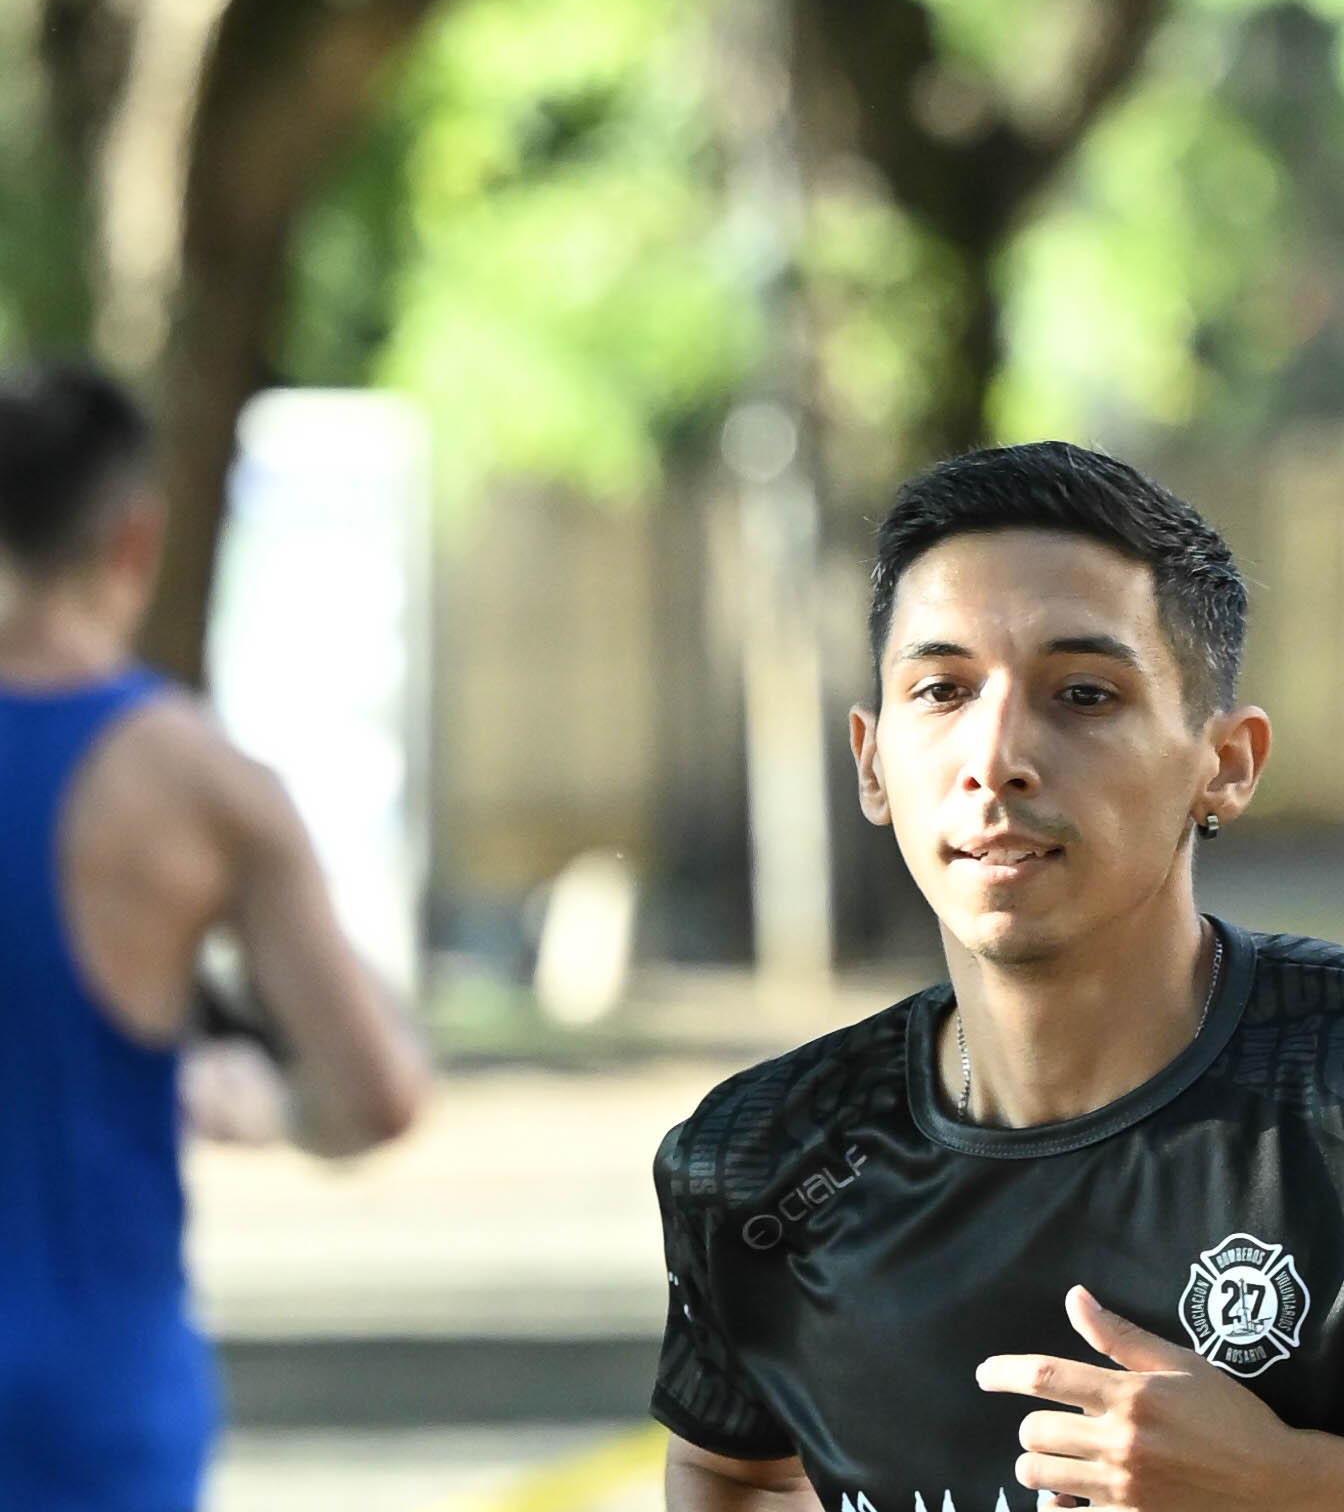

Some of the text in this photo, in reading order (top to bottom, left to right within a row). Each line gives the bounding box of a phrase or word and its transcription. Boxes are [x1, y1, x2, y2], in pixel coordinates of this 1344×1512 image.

[1216, 1247, 1267, 1269] BOMBEROS
[1191, 1280, 1212, 1338] ASOCIACIÓN
[1221, 1279, 1266, 1326] 27
[1274, 1271, 1297, 1332] VOLUNTARIOS
[1225, 1346, 1268, 1365] ROSARIO
